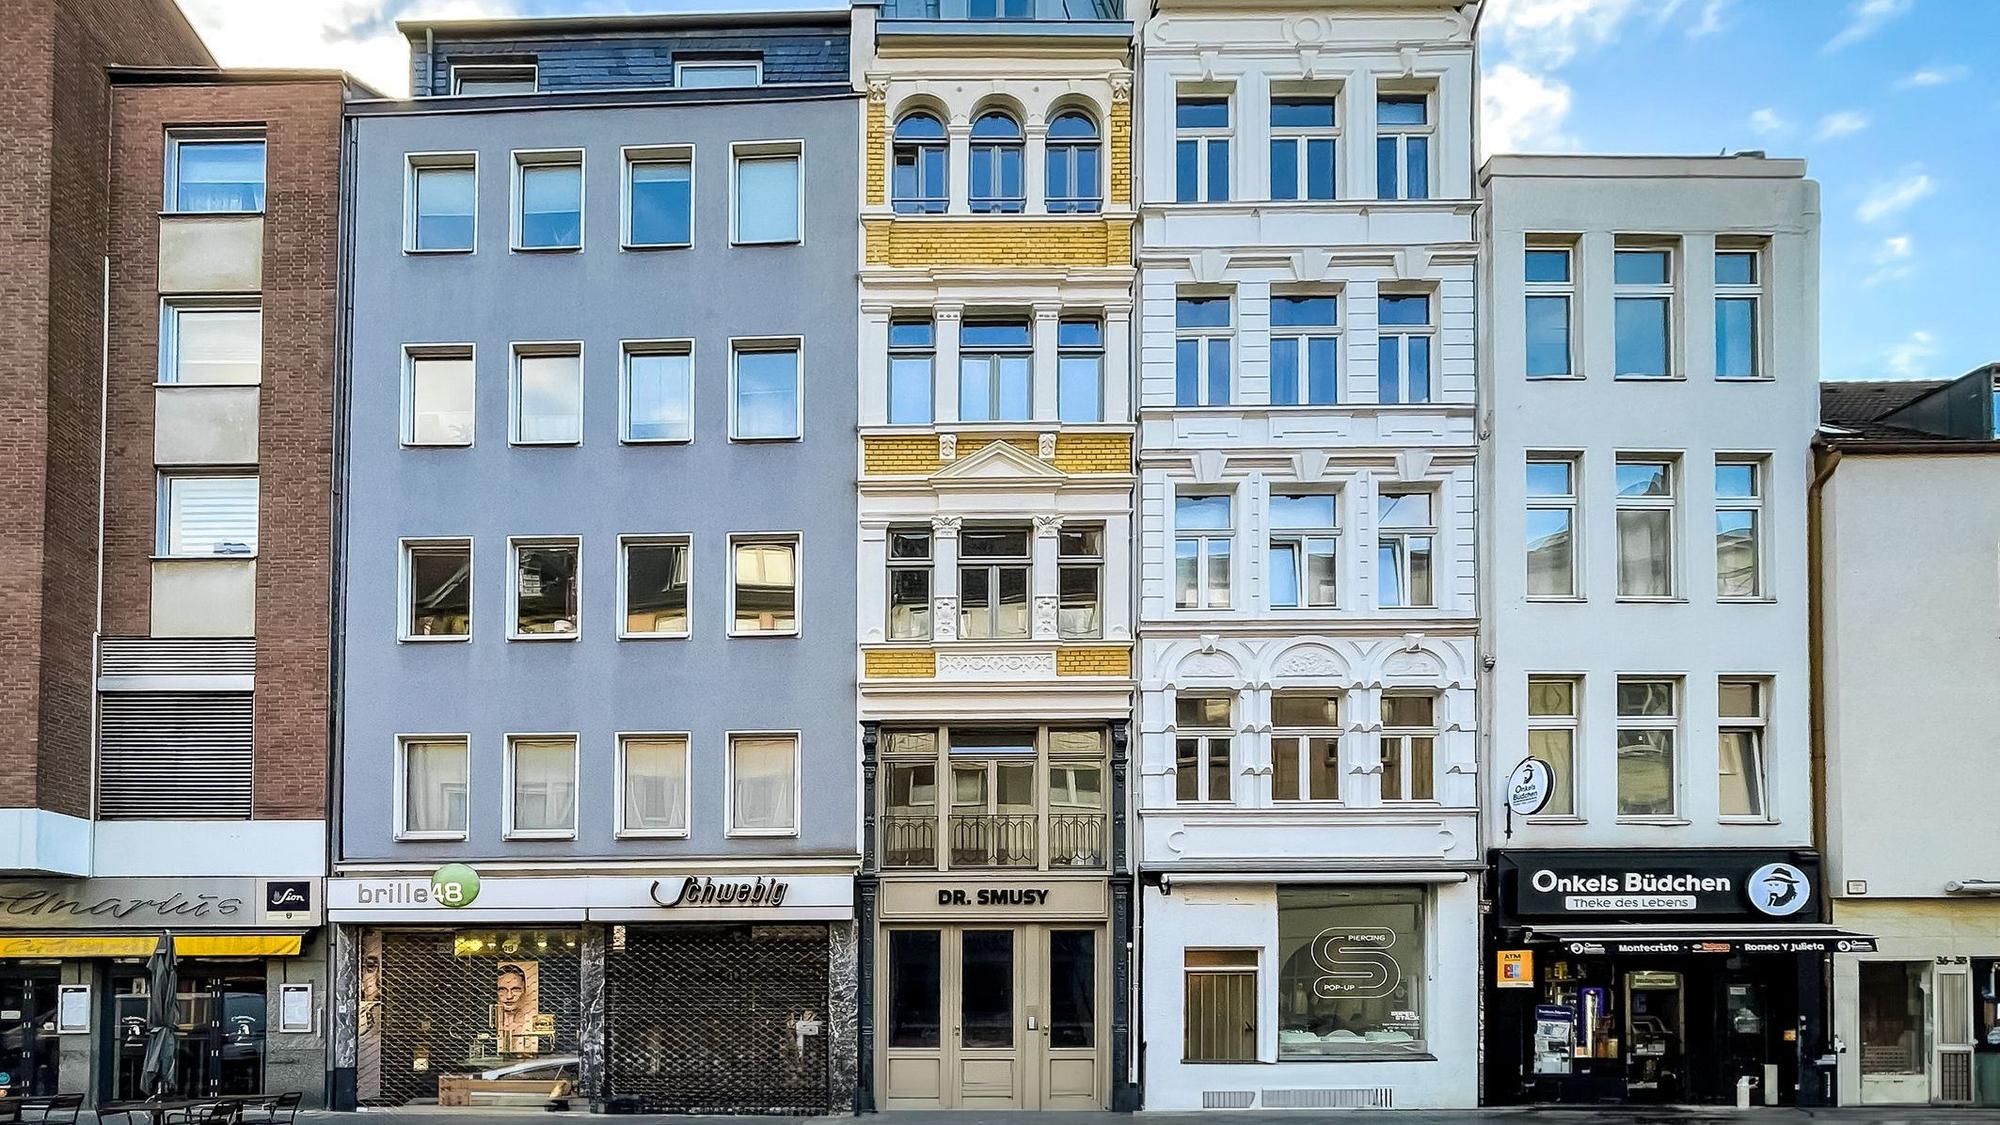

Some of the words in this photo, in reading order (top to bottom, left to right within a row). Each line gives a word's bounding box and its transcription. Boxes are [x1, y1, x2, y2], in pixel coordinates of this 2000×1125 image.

[1532, 869, 1619, 893] Onkels
[1624, 872, 1731, 892] Büdchen
[271, 888, 305, 905] Sion
[650, 876, 788, 907] Schwebig
[938, 889, 972, 905] DR.
[977, 889, 1049, 905] SMUSY
[1573, 898, 1612, 908] Theke
[1614, 898, 1639, 908] des
[1641, 898, 1689, 907] Lebens
[1618, 944, 1679, 952] Montecristo
[1744, 943, 1780, 951] Romeo
[1781, 943, 1789, 951] Y
[1790, 943, 1825, 952] Julieta
